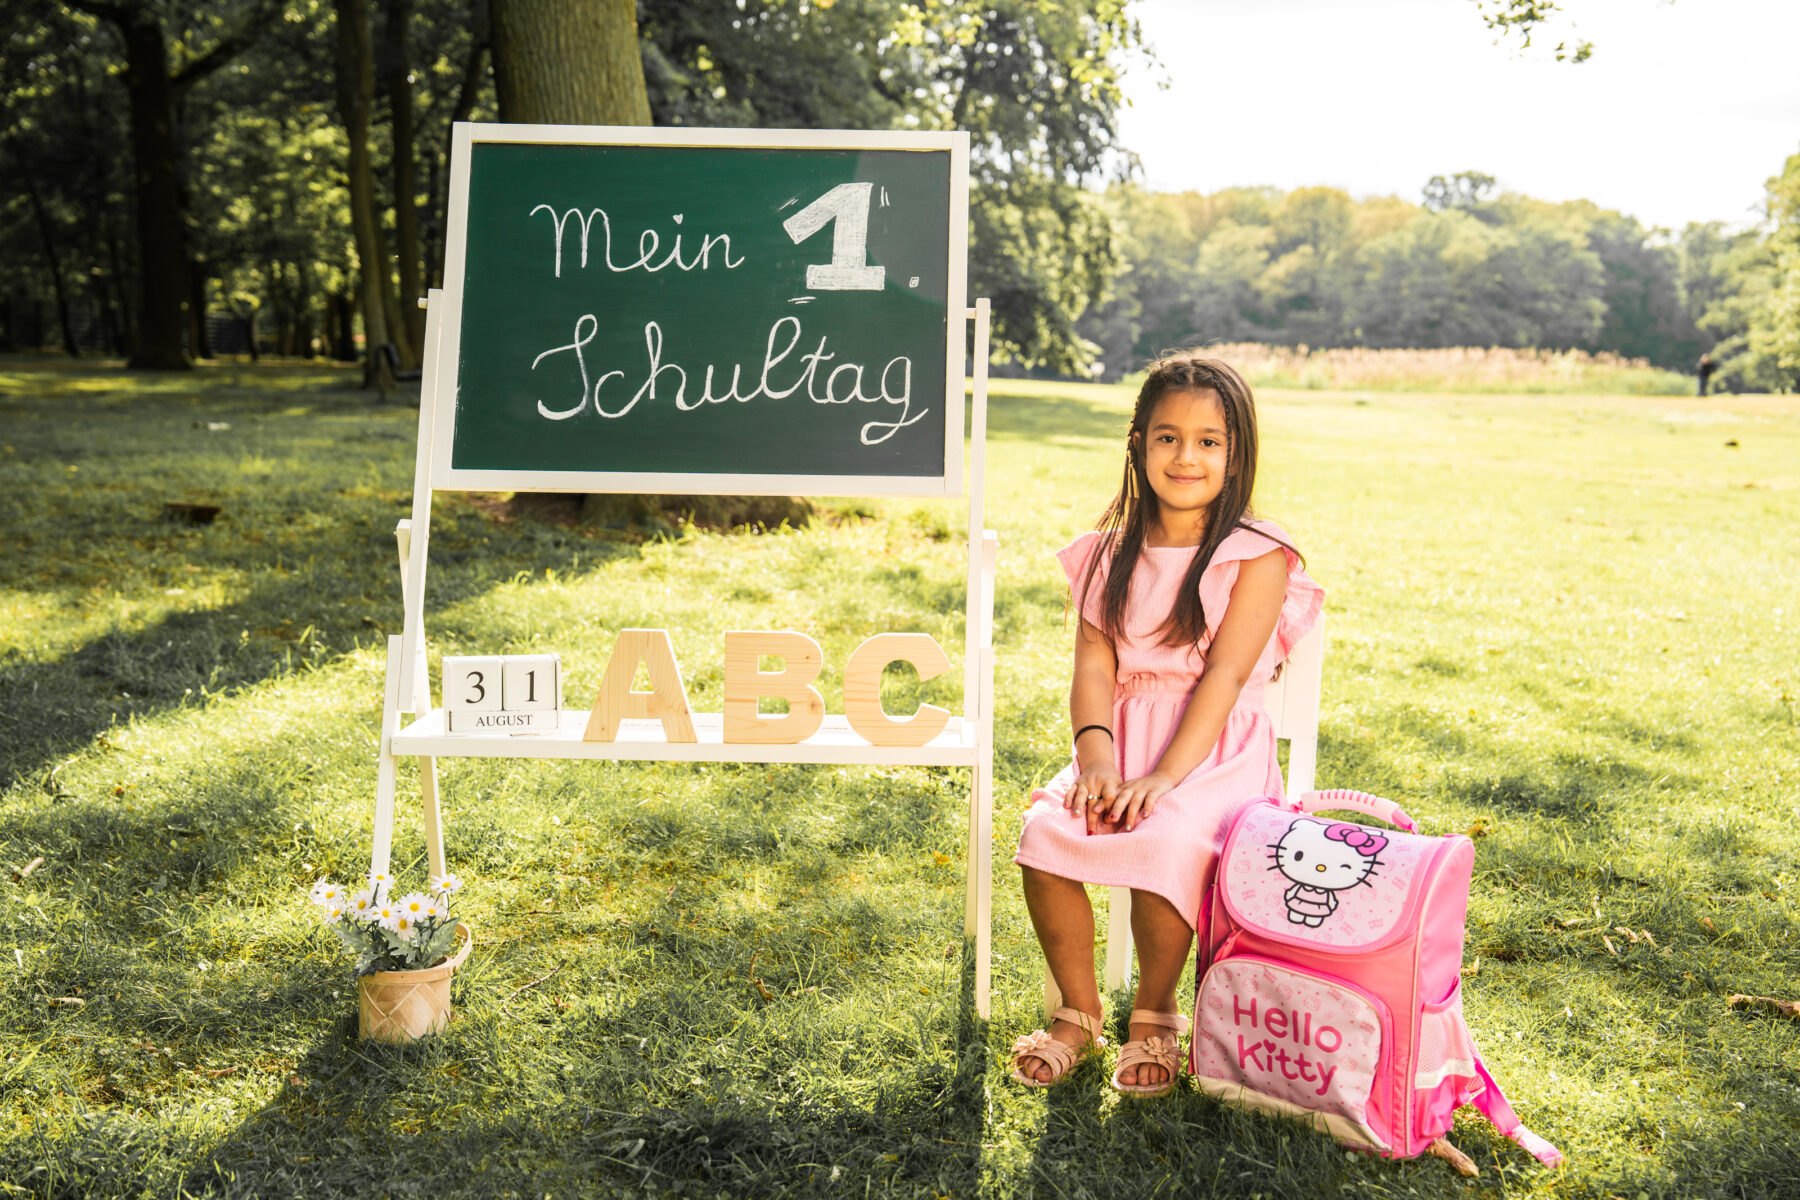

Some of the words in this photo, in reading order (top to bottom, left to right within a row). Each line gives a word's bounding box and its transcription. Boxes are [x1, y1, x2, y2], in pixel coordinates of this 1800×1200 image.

[530, 204, 745, 278] Mein
[532, 314, 929, 445] Schultag
[476, 714, 533, 727] AUGUST
[1233, 994, 1342, 1053] Hello
[1238, 1034, 1337, 1096] Kitty
